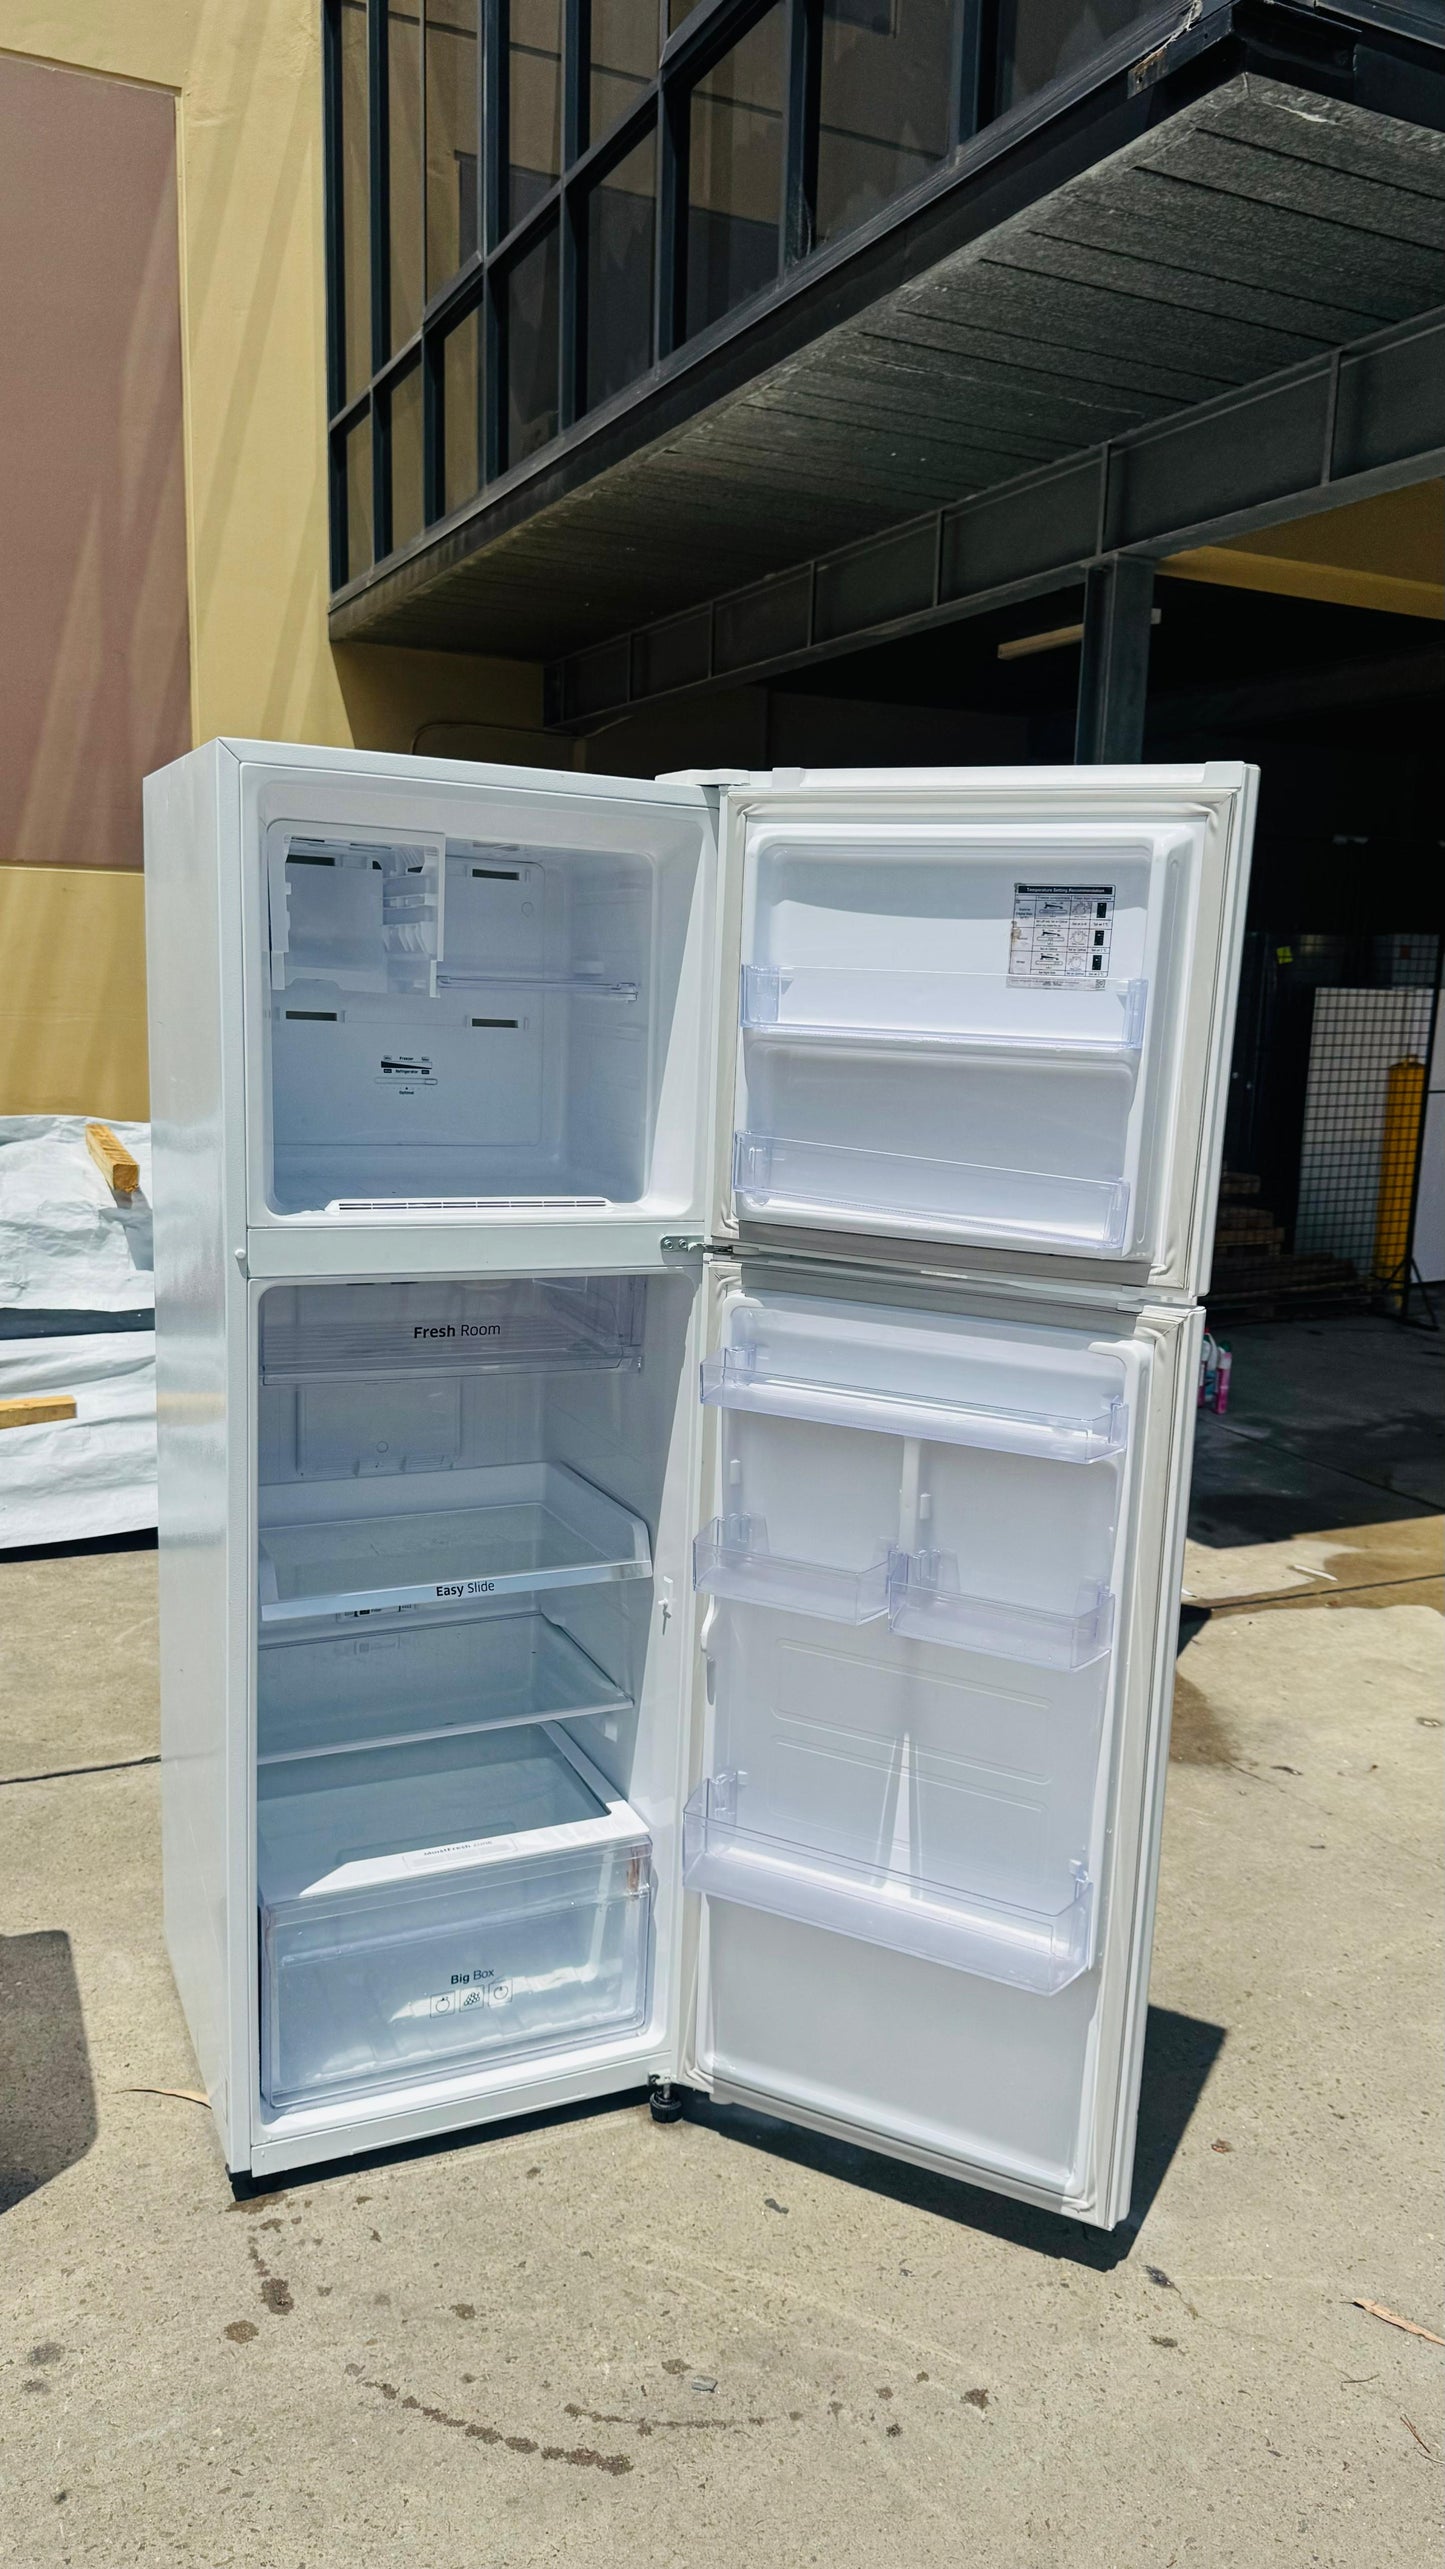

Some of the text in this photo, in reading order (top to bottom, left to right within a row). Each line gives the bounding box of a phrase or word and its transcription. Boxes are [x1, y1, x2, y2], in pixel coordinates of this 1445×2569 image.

[414, 1325, 500, 1338] Fresh Room
[436, 1581, 495, 1597] Easy Slide
[451, 1969, 495, 1985] Big Box
